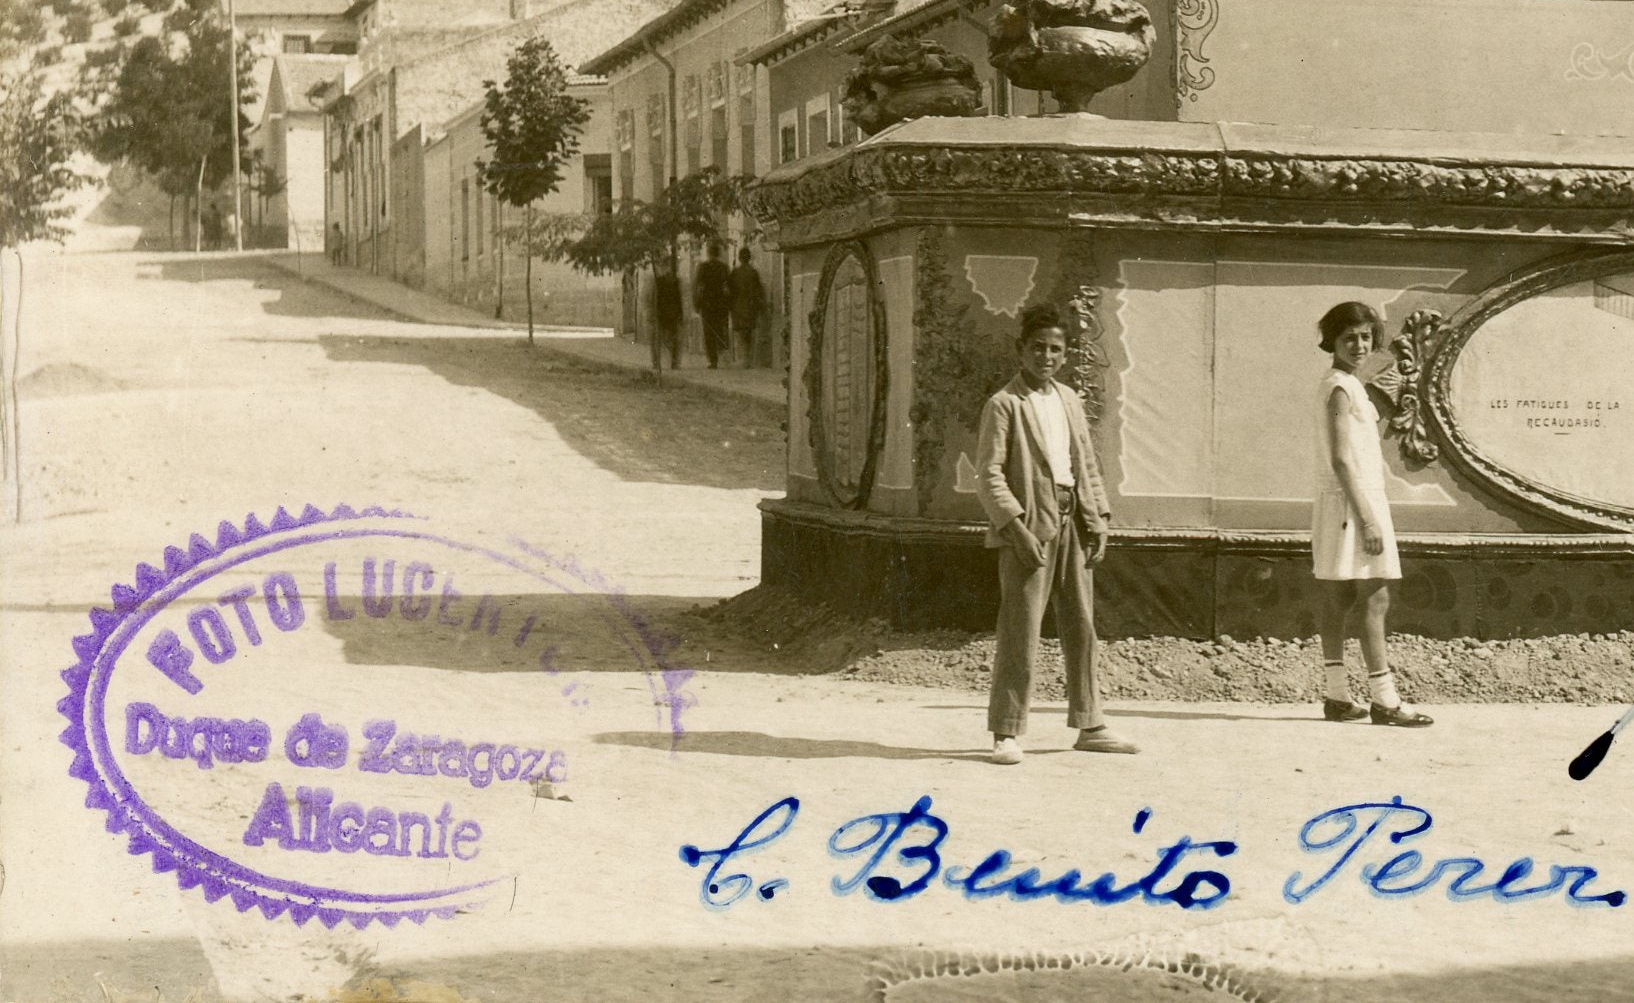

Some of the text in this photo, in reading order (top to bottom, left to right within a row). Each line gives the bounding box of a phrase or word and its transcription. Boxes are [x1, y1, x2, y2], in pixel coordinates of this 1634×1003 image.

[1490, 399, 1620, 410] LES FATIGUES DE LA
